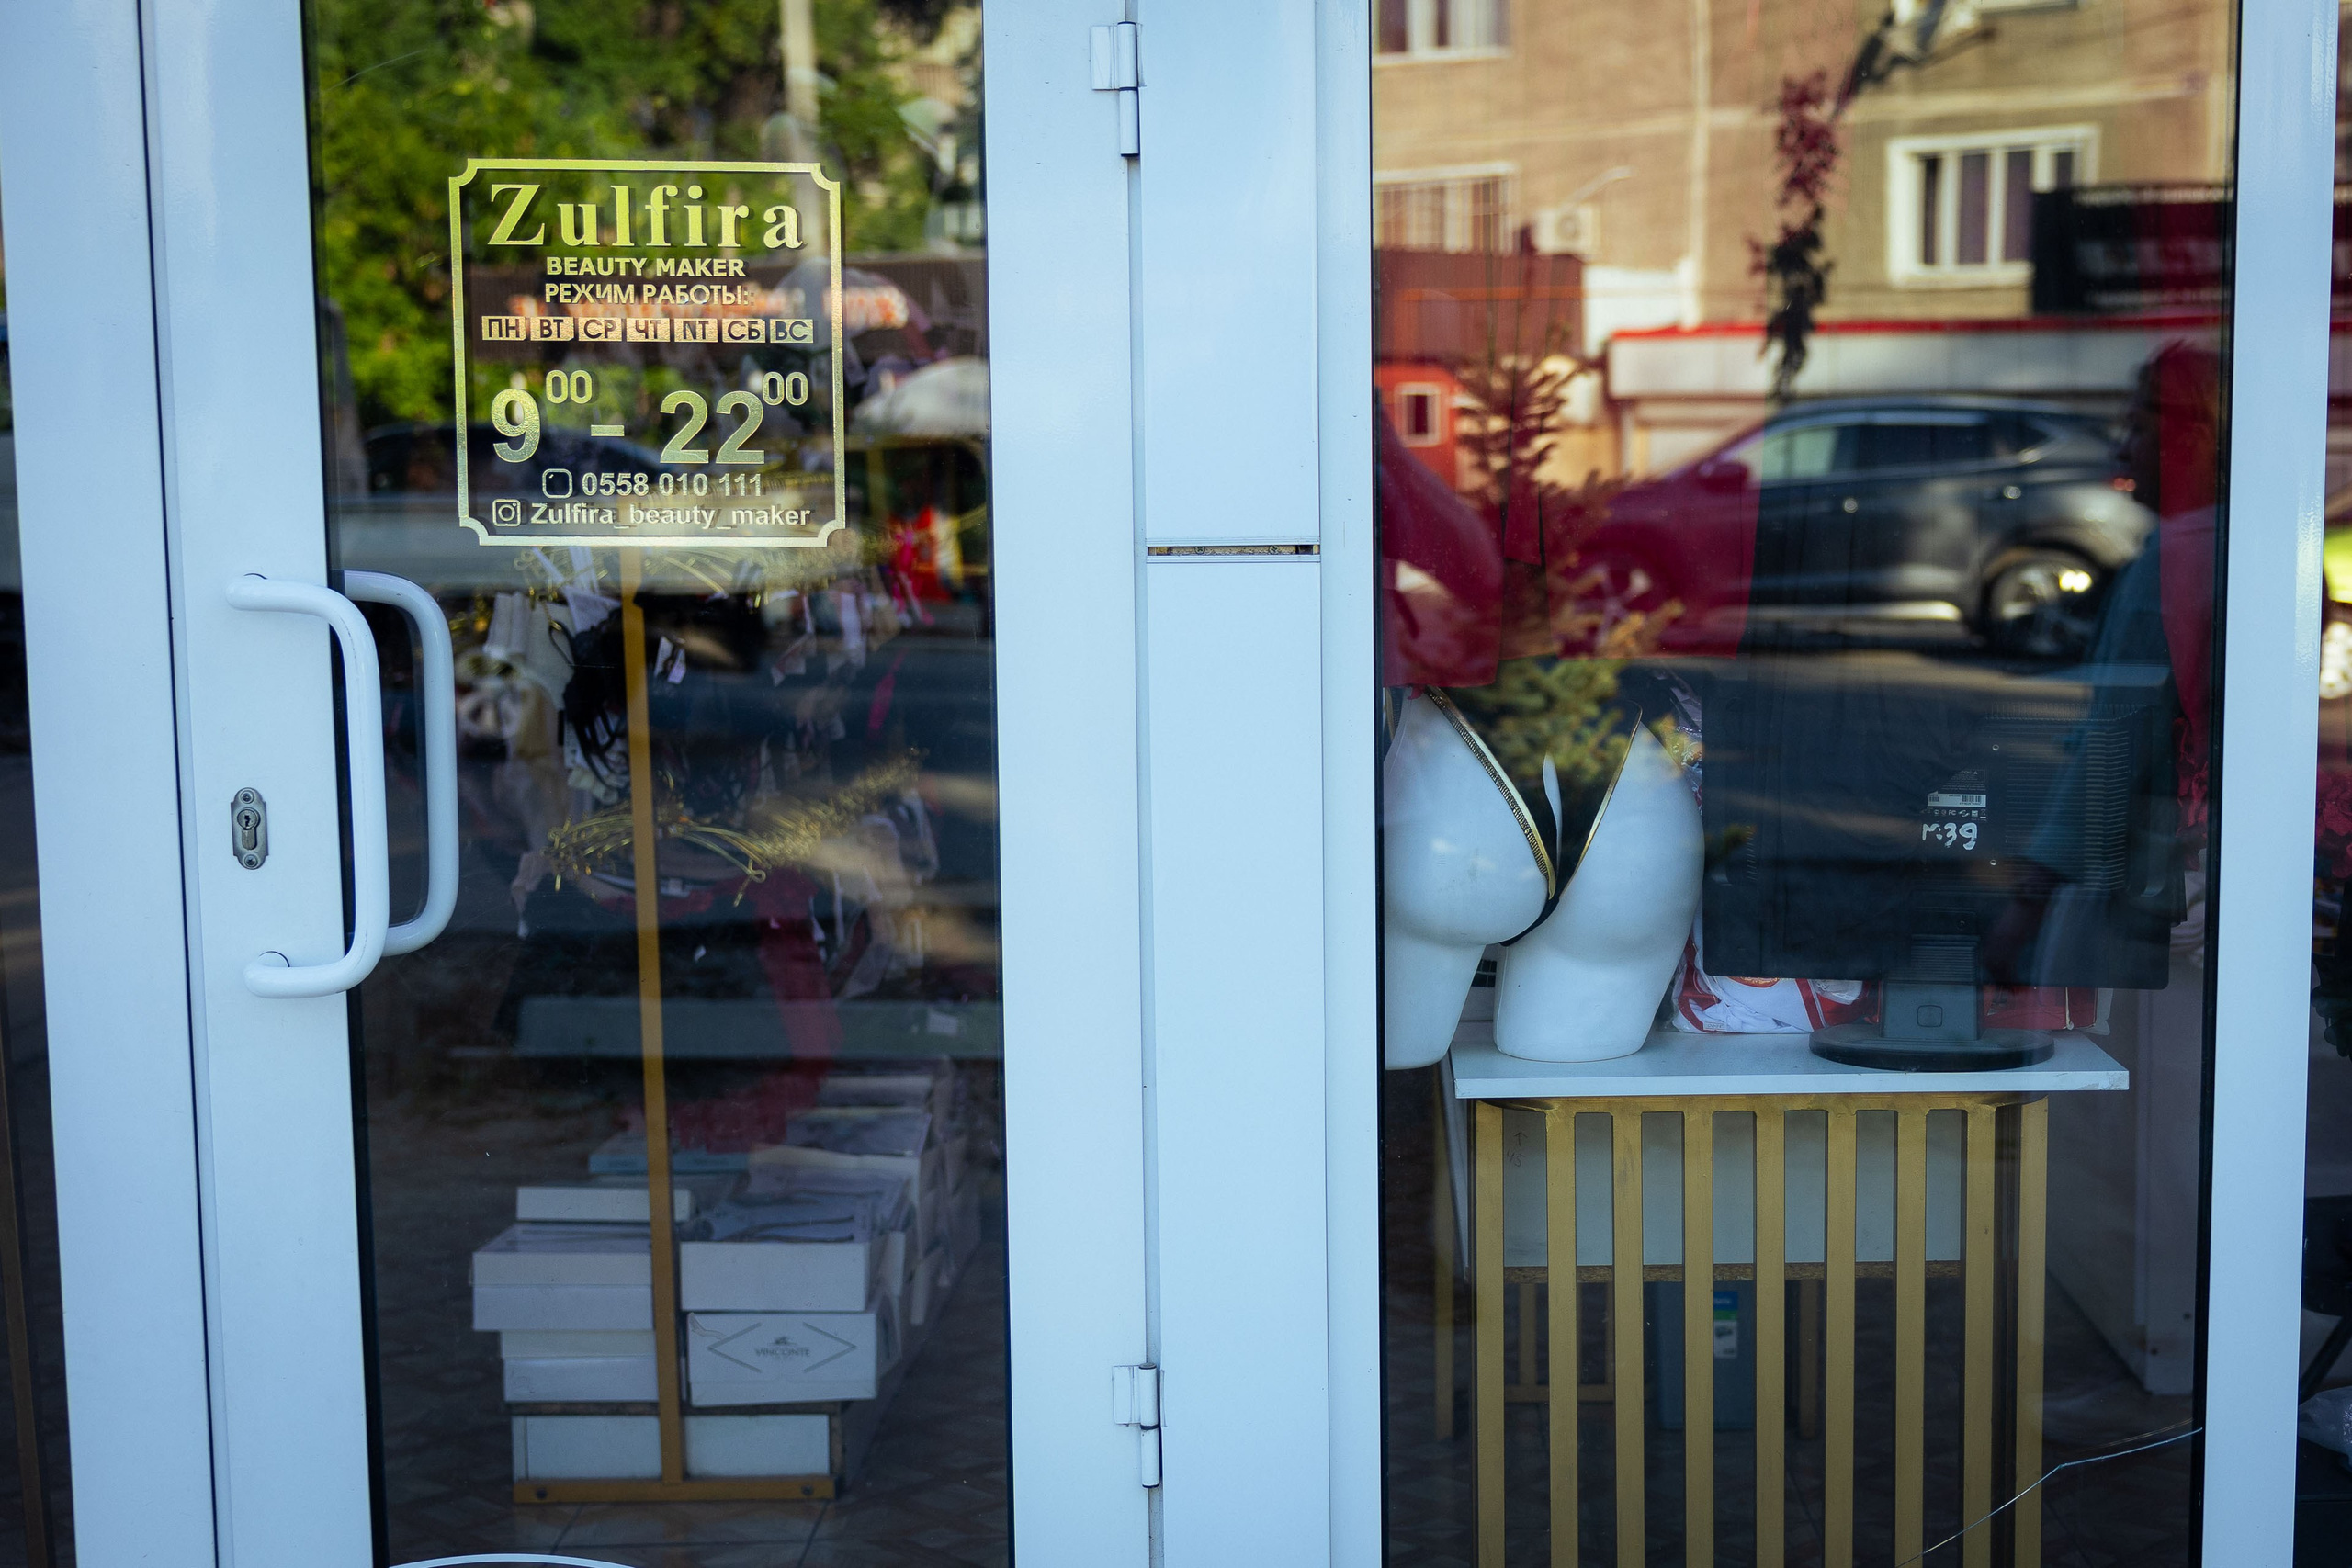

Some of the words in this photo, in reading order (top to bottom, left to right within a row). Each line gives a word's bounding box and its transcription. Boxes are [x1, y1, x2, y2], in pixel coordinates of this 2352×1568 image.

[487, 184, 804, 249] Zulfira
[546, 256, 648, 276] BEAUTY
[656, 258, 747, 277] MAKER
[545, 283, 635, 304] РЕЖИМ
[488, 318, 520, 338] ПН
[539, 319, 564, 339] ВТ
[583, 319, 617, 339] СР
[635, 320, 662, 340] ЧТ
[727, 320, 761, 341] СБ
[775, 321, 808, 341] ВС
[491, 388, 541, 463] 9
[545, 369, 593, 404] 00
[659, 389, 765, 465] 22
[762, 371, 808, 406] 00
[582, 472, 650, 496] 0558
[658, 472, 708, 497] 010
[718, 472, 762, 497] 111
[530, 502, 811, 530] Zulfira_beauty_maker
